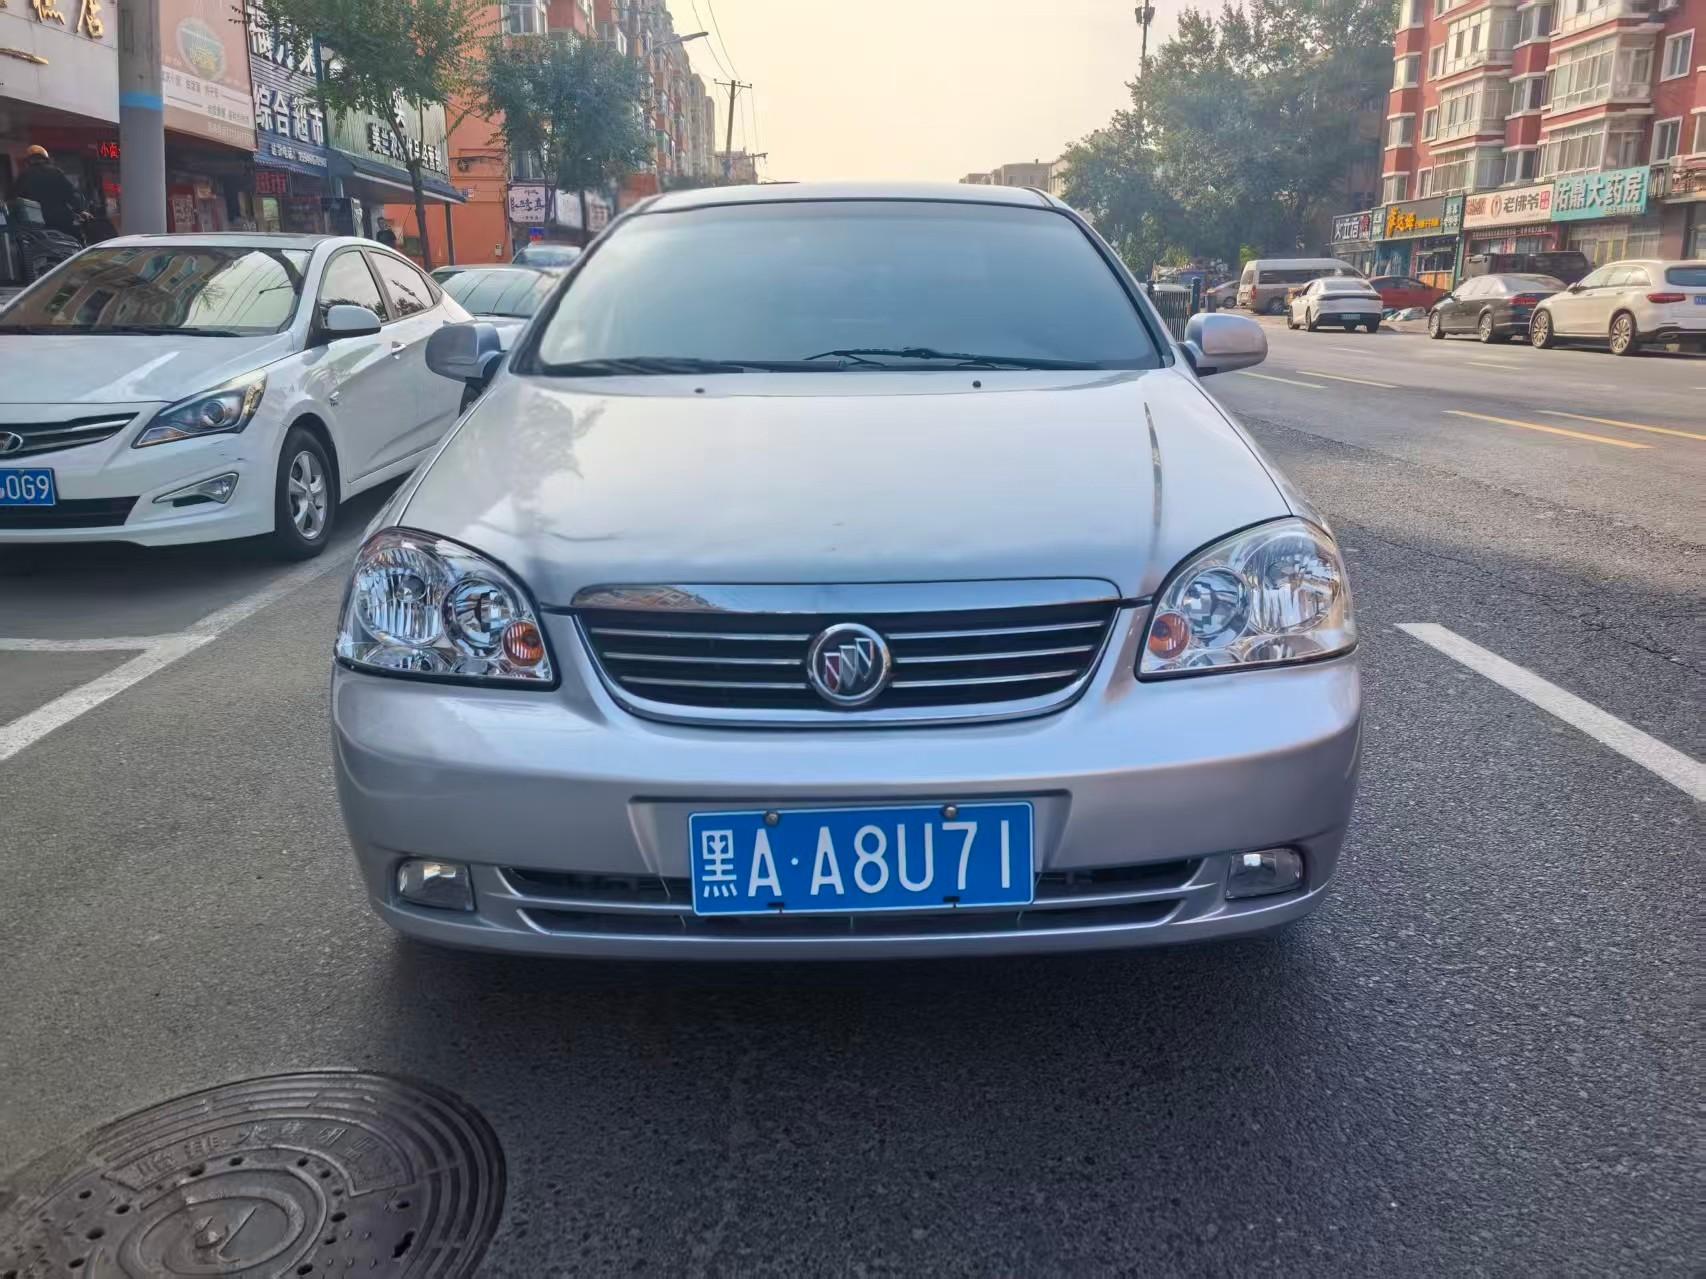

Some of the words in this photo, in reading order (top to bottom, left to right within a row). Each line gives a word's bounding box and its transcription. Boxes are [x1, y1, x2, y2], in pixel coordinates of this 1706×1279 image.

[1503, 192, 1540, 214] 老佛爷
[0, 475, 49, 500] 0G9
[701, 819, 1012, 898] 黑A·A8U71
